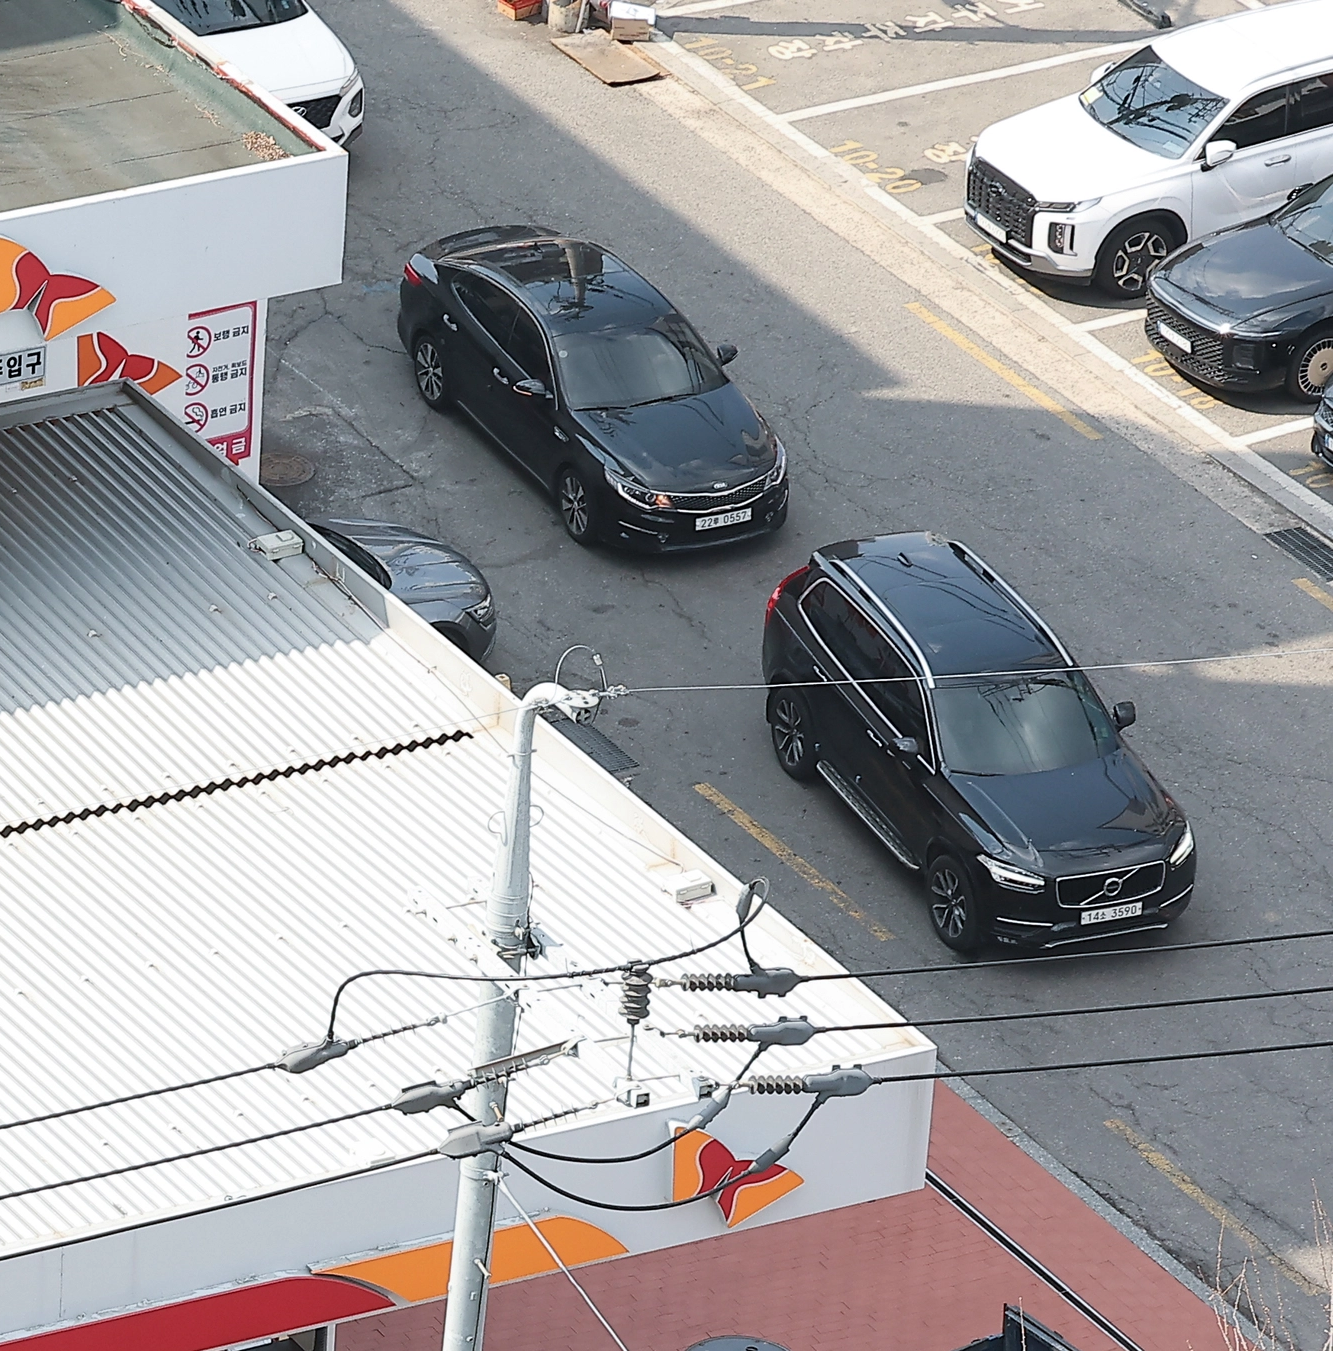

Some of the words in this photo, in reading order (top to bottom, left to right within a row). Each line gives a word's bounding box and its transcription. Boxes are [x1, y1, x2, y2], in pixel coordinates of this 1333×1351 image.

[833, 139, 923, 193] 10-20
[213, 329, 230, 342] 보행
[232, 325, 250, 338] 금지
[212, 371, 228, 384] 통행
[231, 367, 247, 379] 금지
[210, 407, 227, 419] 흡연
[230, 402, 246, 414] 금지
[723, 511, 747, 524] 0557
[1111, 905, 1137, 918] 3590
